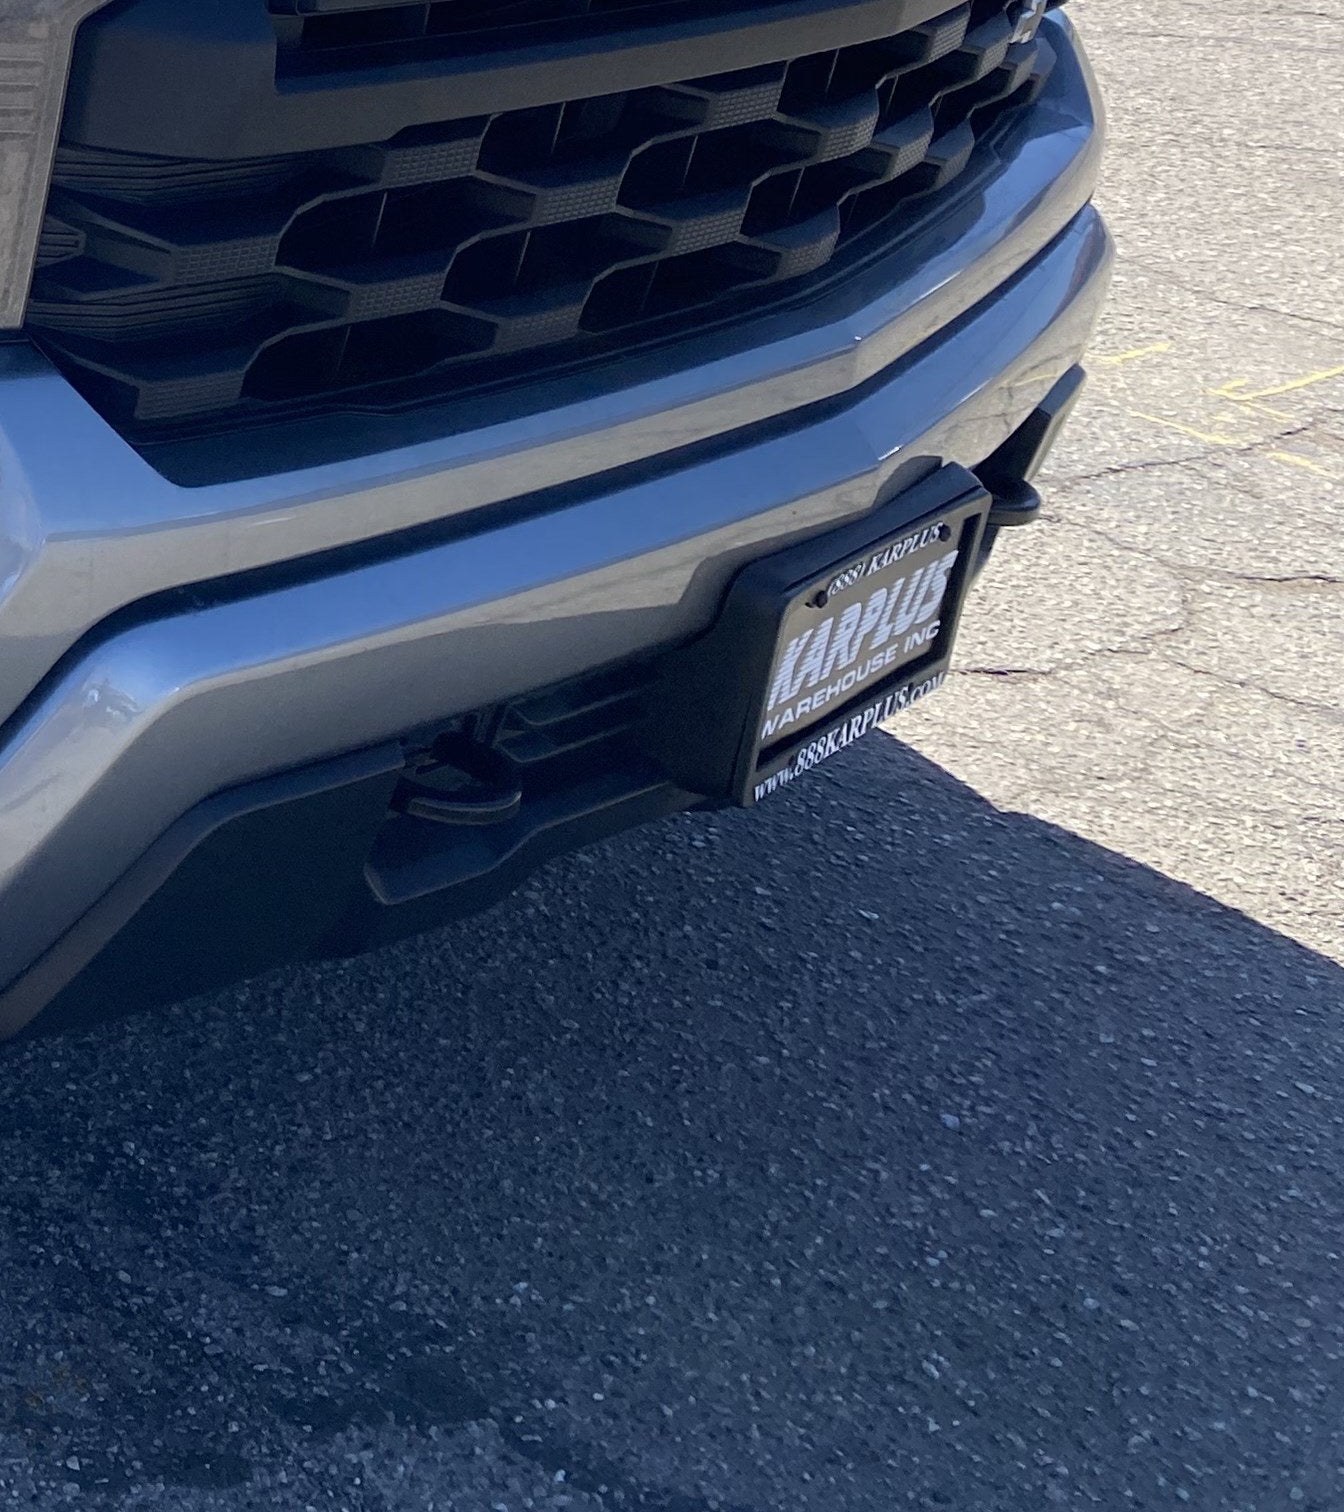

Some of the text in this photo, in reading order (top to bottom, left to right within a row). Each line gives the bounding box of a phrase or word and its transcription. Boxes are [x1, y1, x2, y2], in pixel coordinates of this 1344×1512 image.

[866, 521, 944, 577] KARPLUS
[767, 550, 959, 712] KARPLUS
[761, 643, 899, 740] WAREHOUSE
